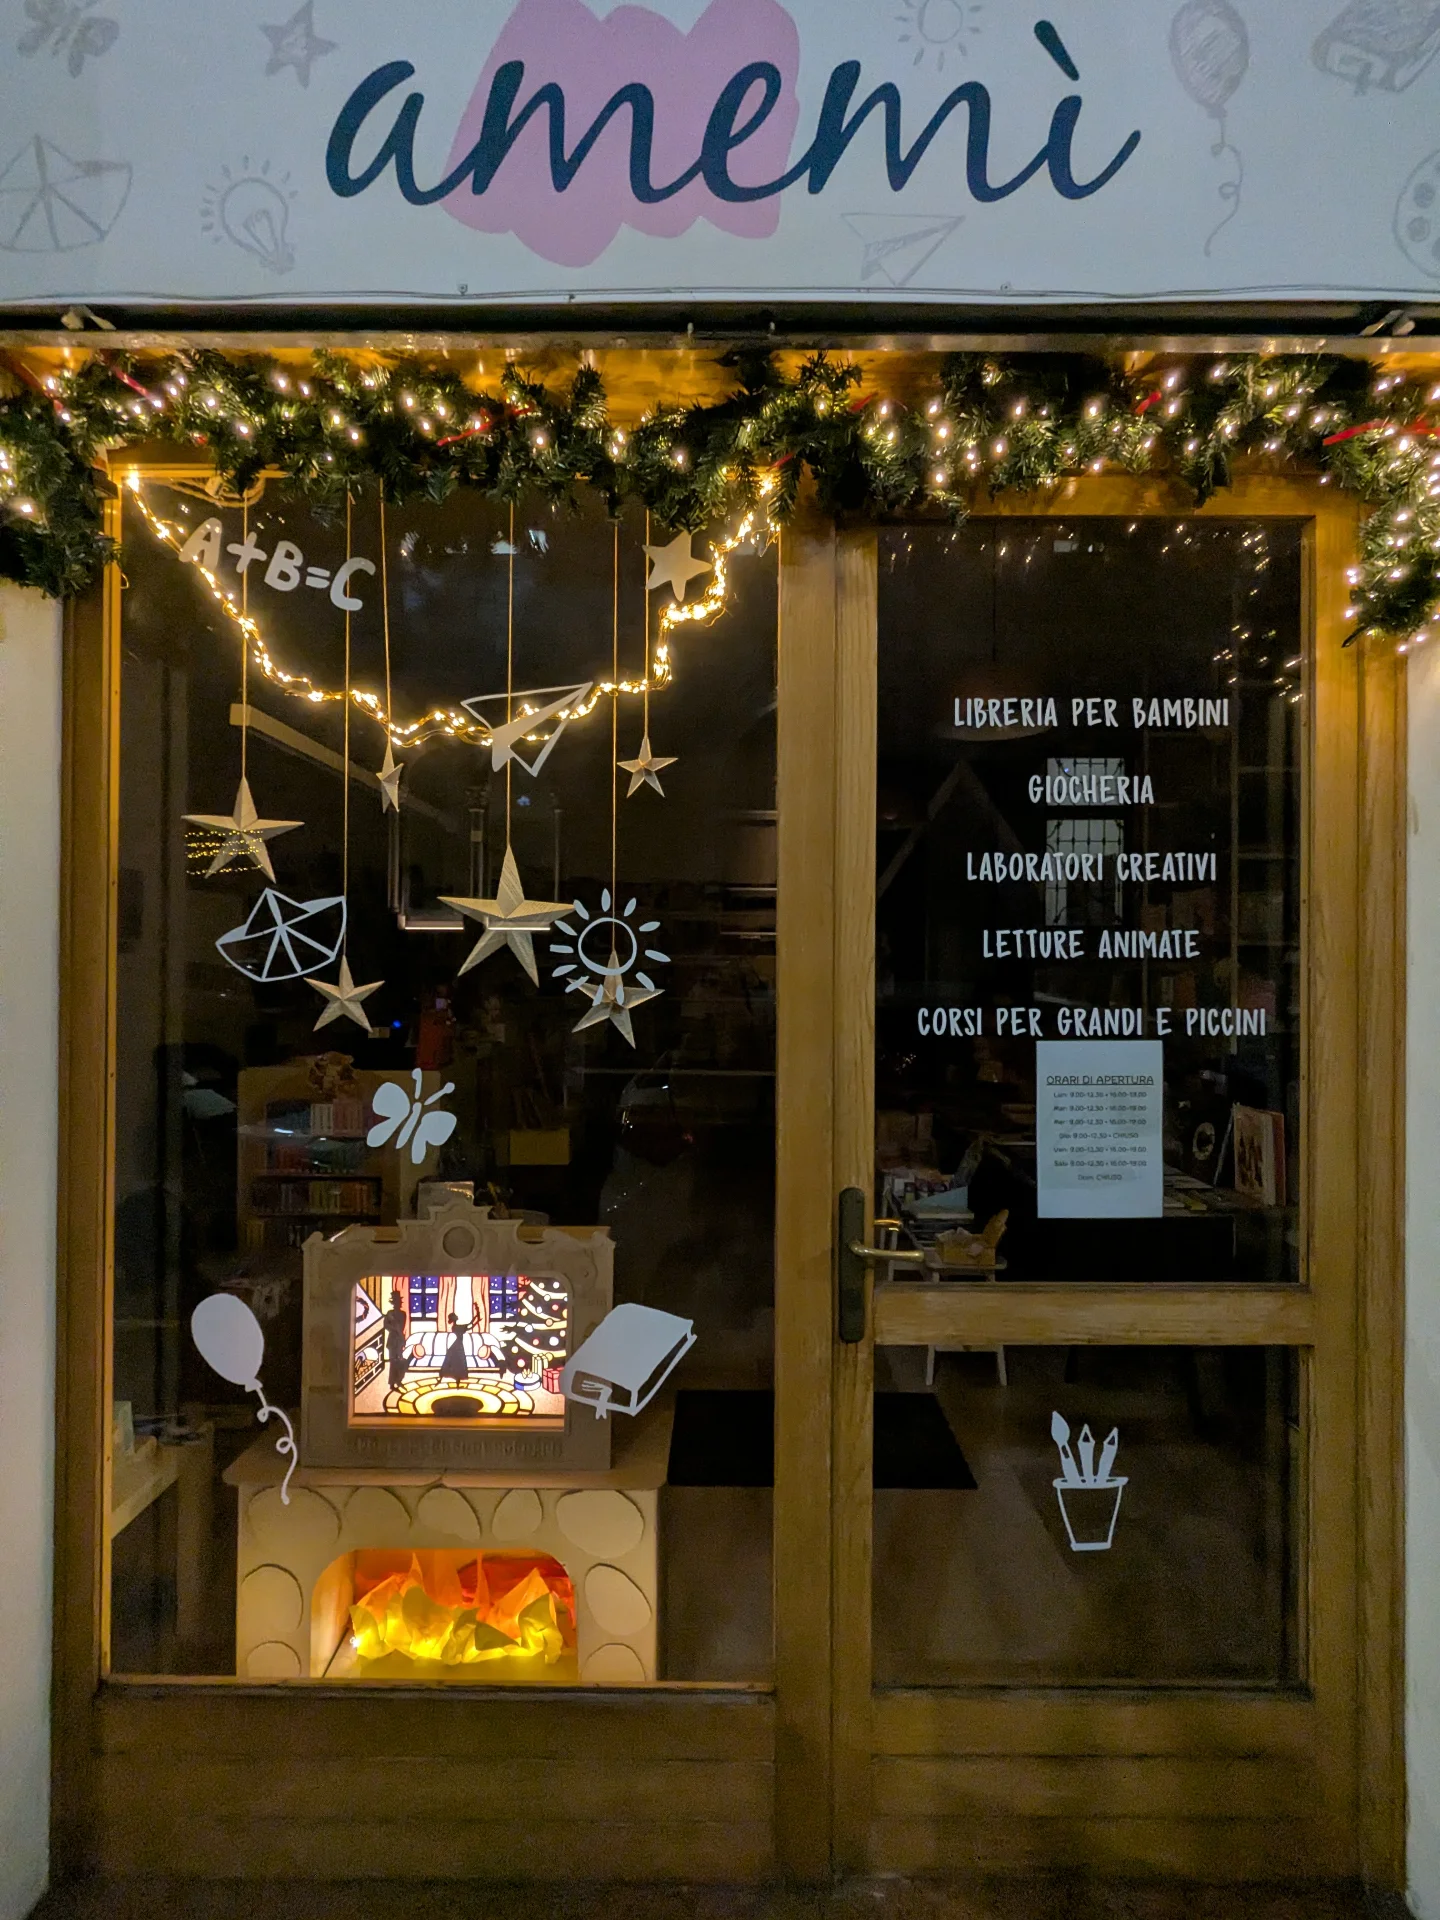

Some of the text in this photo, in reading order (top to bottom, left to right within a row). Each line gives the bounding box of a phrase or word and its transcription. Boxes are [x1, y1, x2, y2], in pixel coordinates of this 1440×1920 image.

[325, 19, 1141, 205] amemì
[178, 517, 376, 612] A+B=C
[953, 697, 1230, 728] LIBRERIA PER BAMBINI
[1028, 774, 1155, 805] GIOCHERIA
[966, 852, 1217, 882] LABORATORI CREATIVI
[982, 929, 1201, 960] LETTURE ANIMATE
[917, 1007, 1267, 1037] CORSI PER GRANDI E PICCINI
[1046, 1075, 1154, 1085] ORARI DI APERTURA
